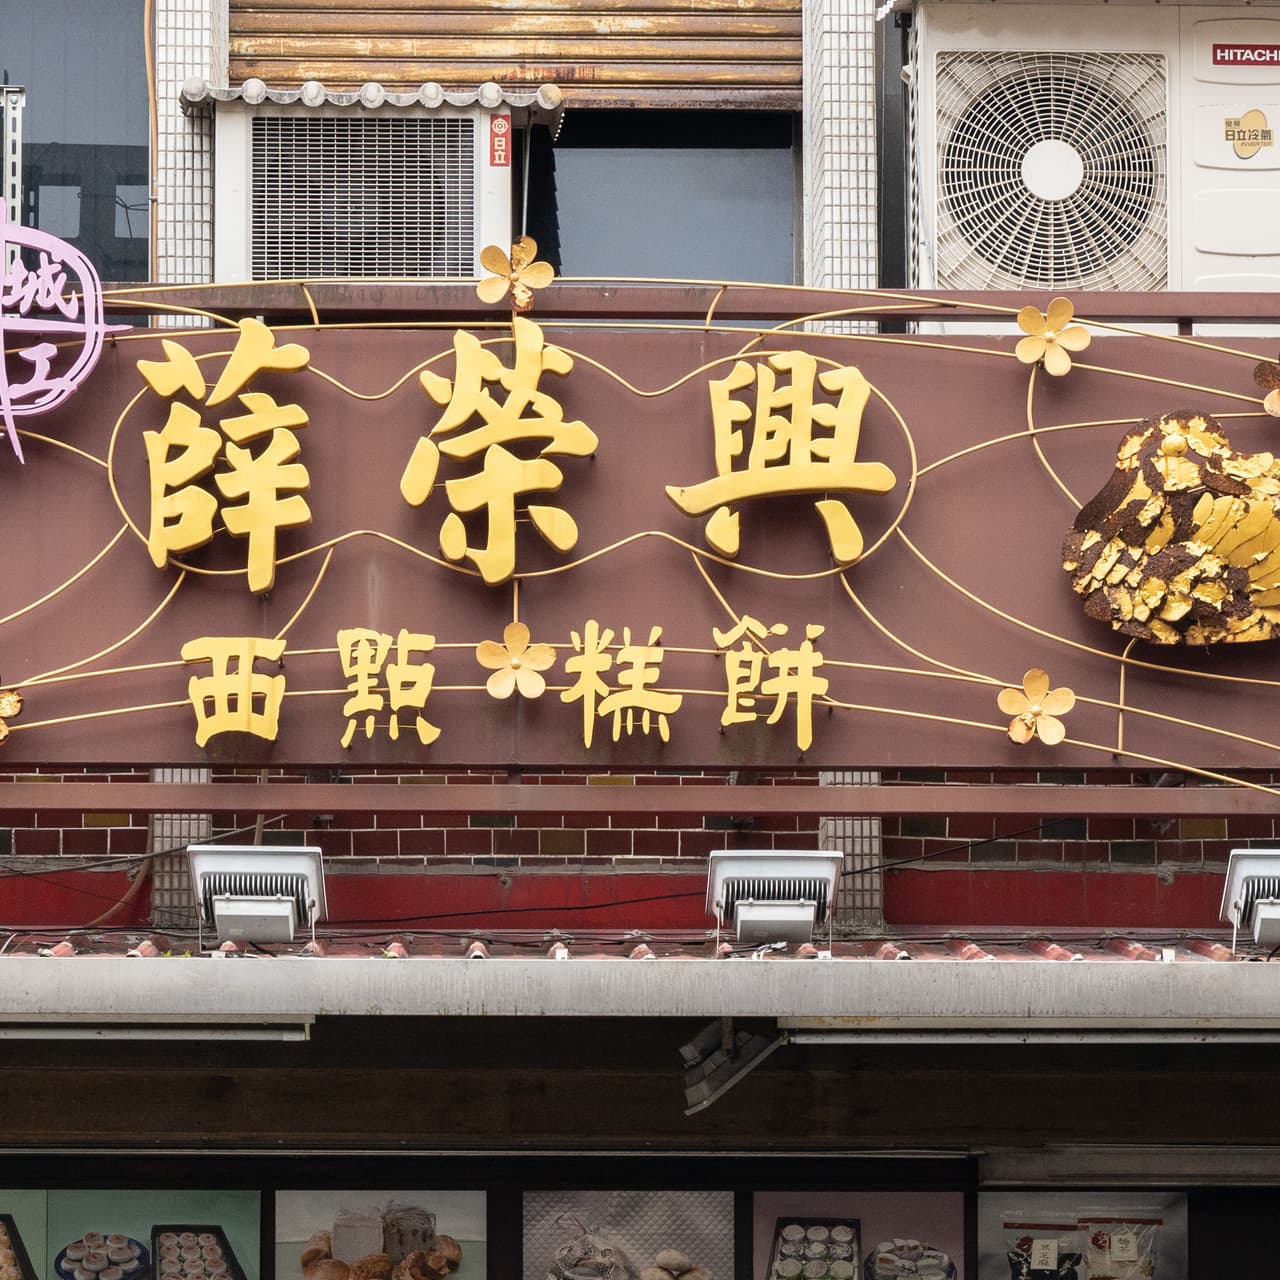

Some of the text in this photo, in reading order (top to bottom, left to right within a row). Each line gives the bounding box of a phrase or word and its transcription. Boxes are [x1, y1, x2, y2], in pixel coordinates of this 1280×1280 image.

[493, 137, 506, 164] 日立
[1225, 129, 1272, 141] 日立冷氣
[136, 317, 897, 595] 薛榮興
[181, 615, 832, 752] 西點糕餅
